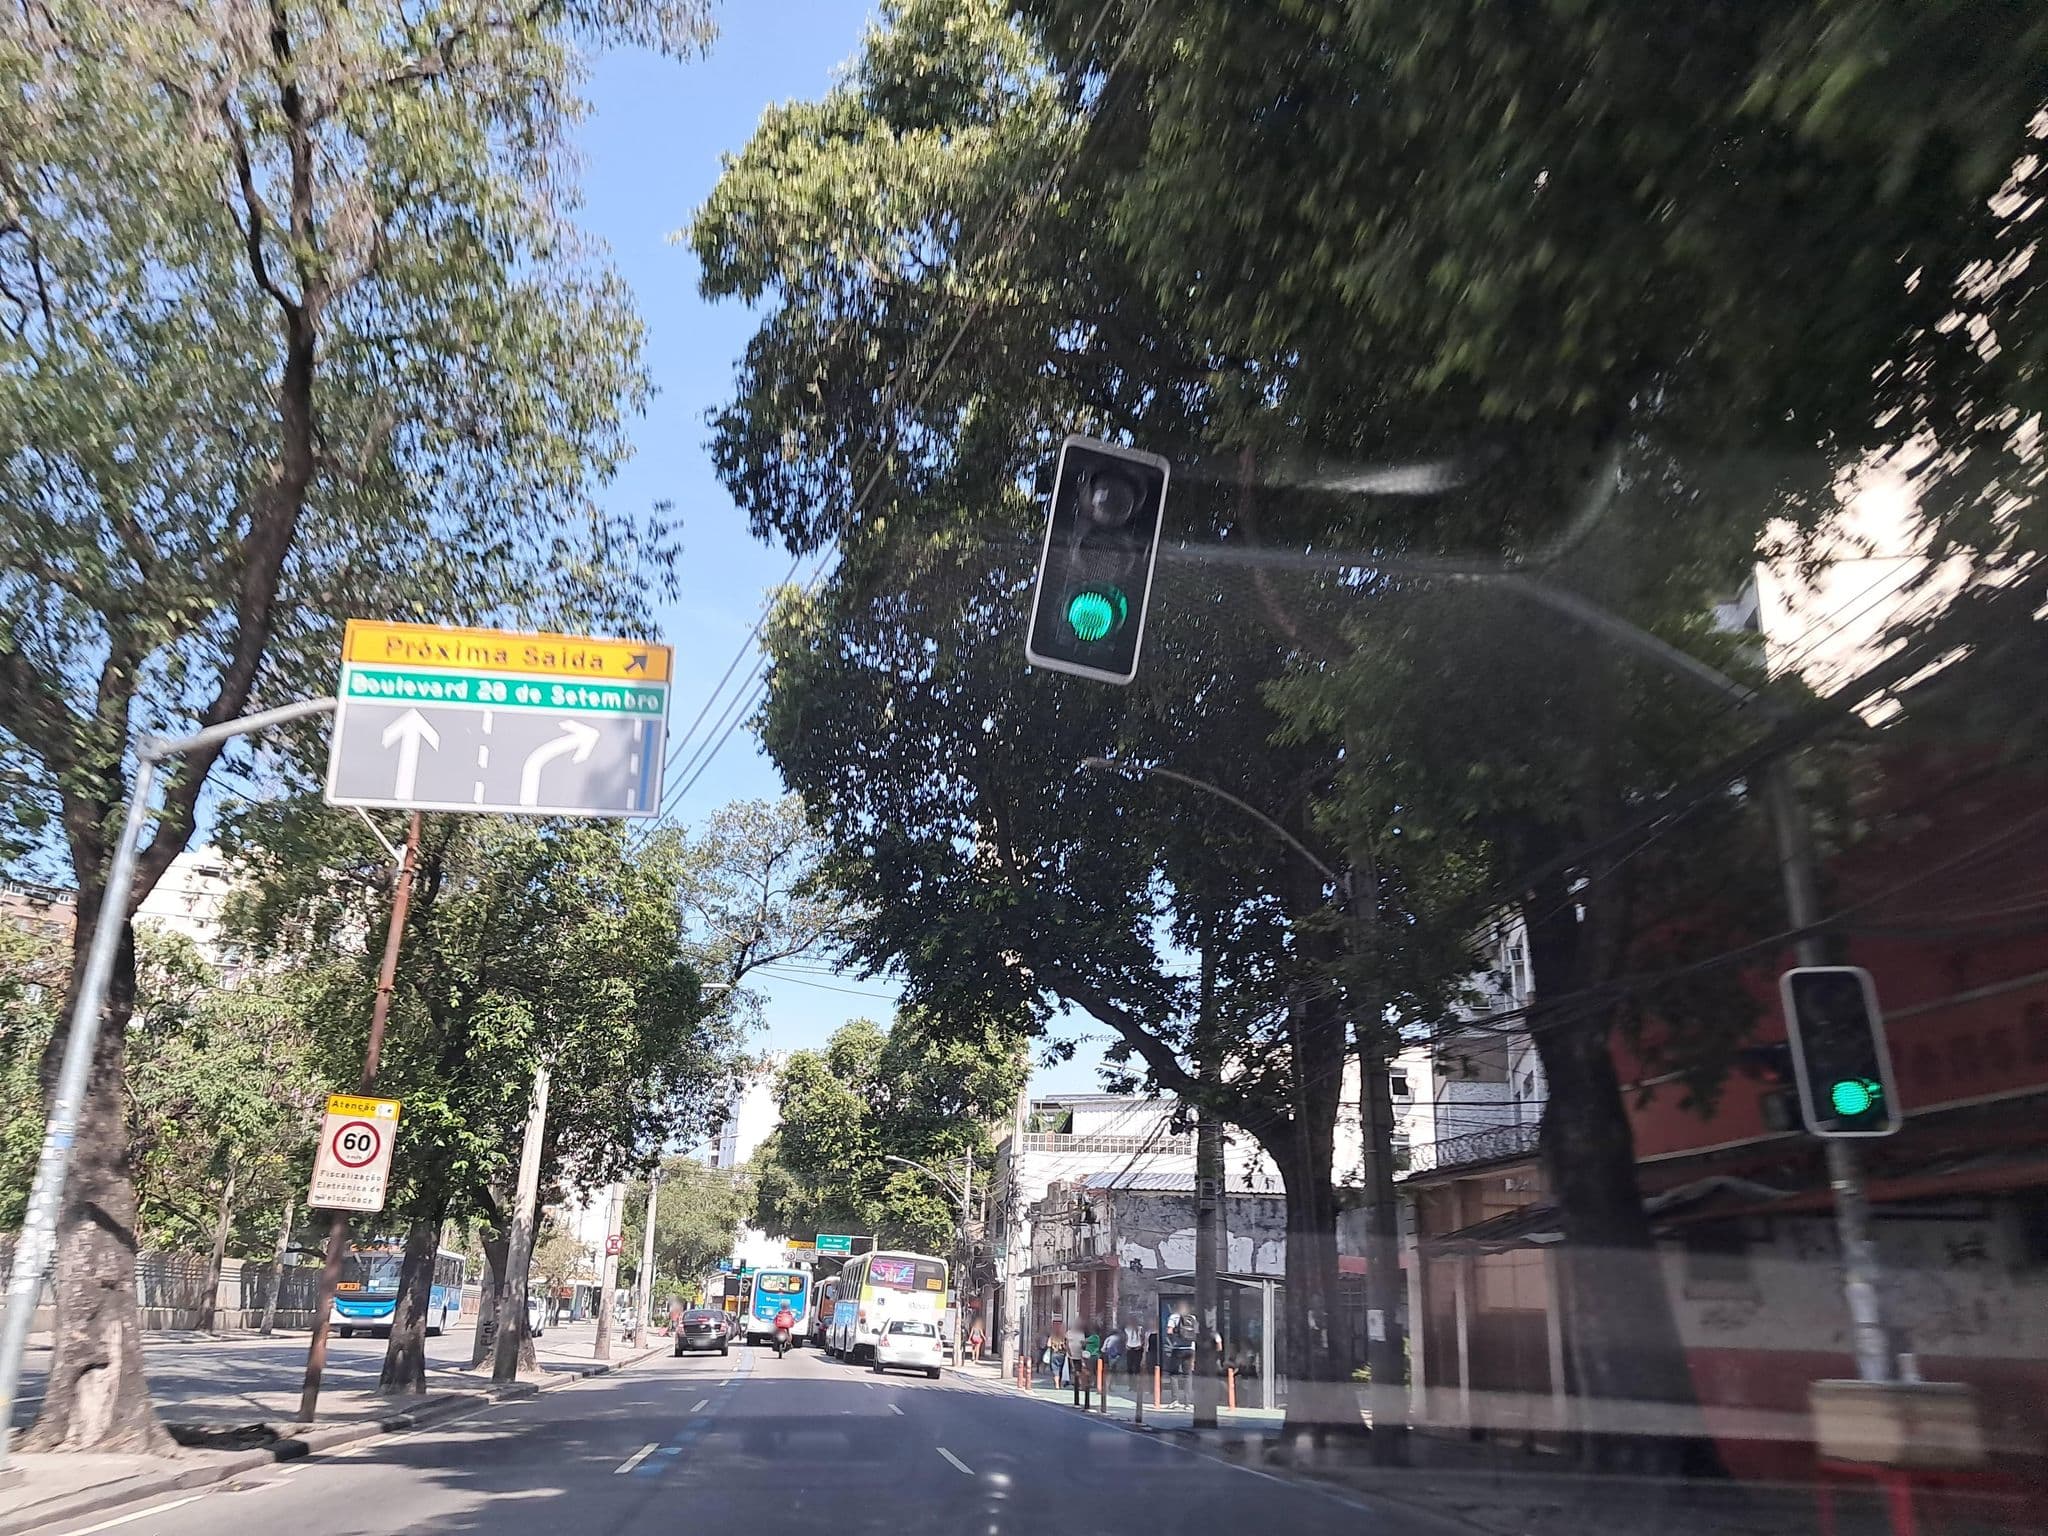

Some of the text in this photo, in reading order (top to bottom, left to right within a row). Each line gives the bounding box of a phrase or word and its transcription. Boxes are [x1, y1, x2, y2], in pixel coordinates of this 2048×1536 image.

[386, 634, 508, 665] Próxima
[351, 674, 658, 709] Boulevard 28 de Setembro
[332, 1100, 376, 1112] Atenção
[344, 1133, 371, 1151] 60
[319, 1170, 381, 1181] Fiscalização
[322, 1194, 373, 1204] elocidade
